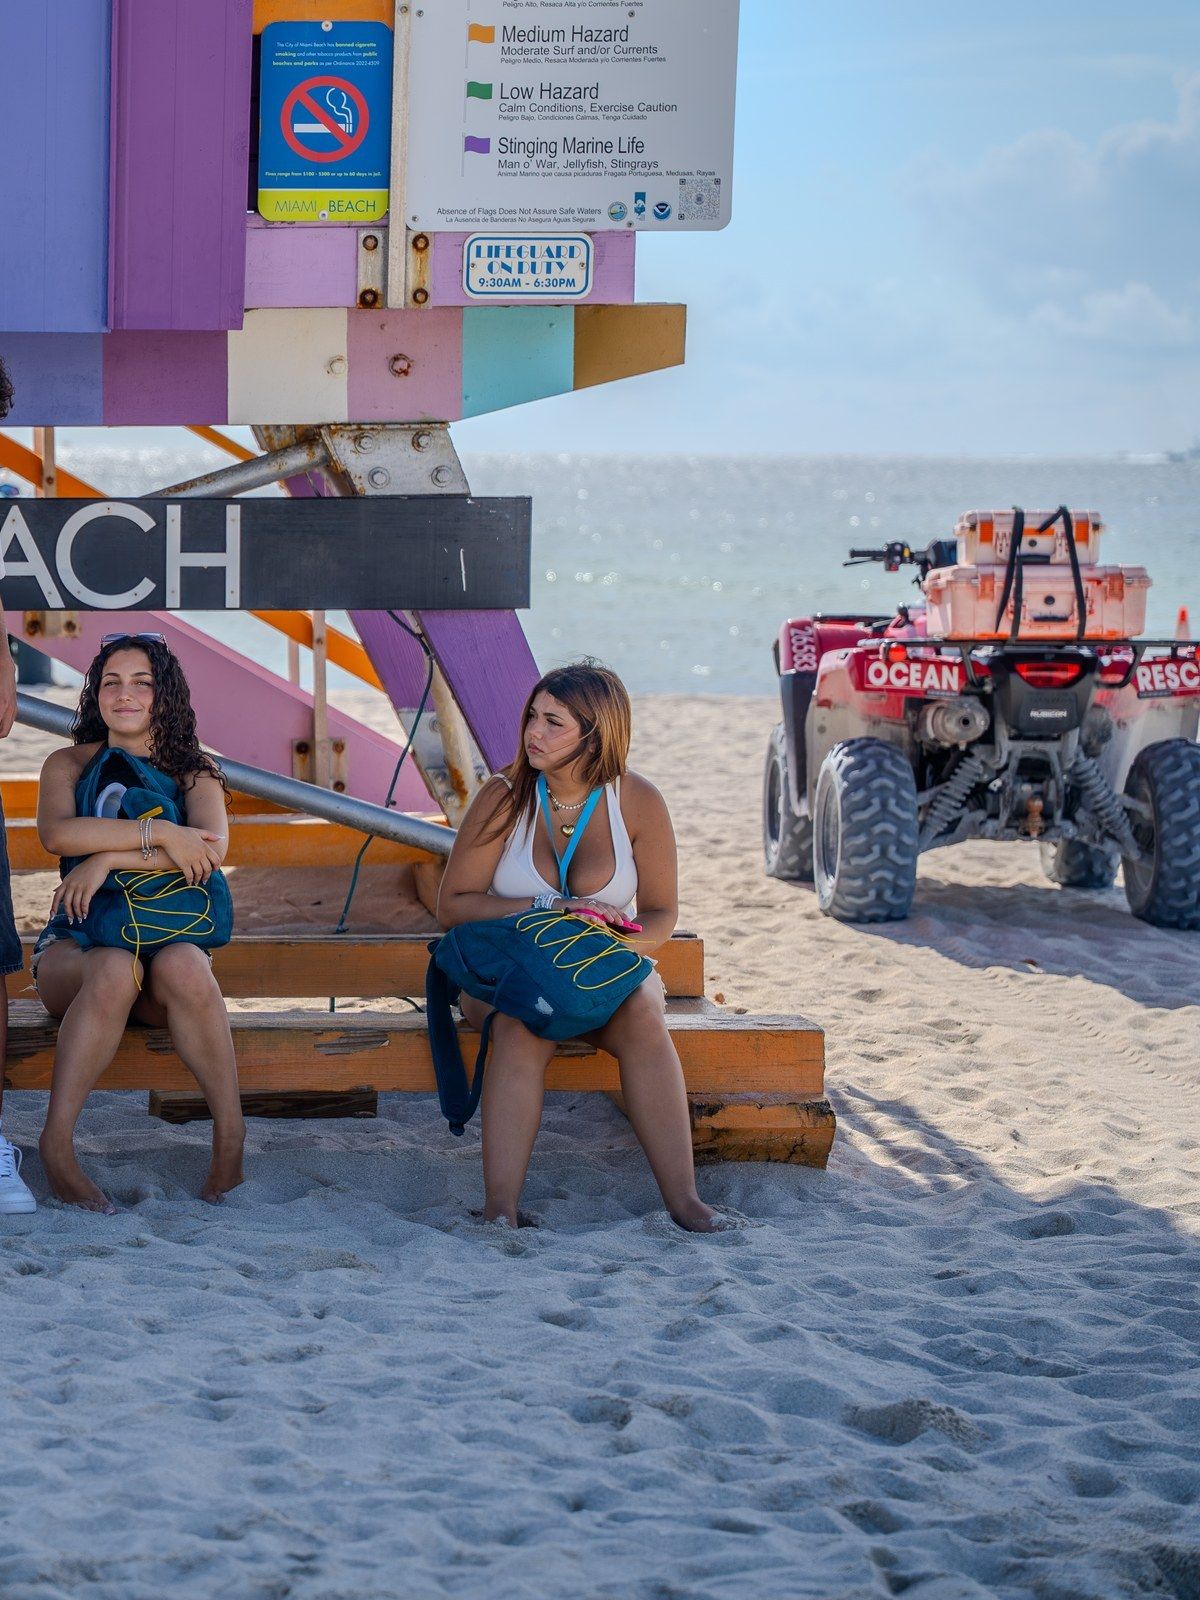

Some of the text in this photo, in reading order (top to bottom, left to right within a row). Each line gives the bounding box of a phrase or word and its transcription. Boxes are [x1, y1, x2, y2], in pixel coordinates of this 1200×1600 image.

[502, 25, 629, 43] Medium Hazard
[501, 44, 658, 56] Moderate Surf and/or Currents
[500, 82, 599, 99] Low Hazard
[499, 102, 677, 112] Calm Conditions, Exercise Caution
[498, 137, 644, 158] Stinging Marine Life
[497, 160, 520, 168] Man
[536, 160, 559, 168] War,
[563, 159, 607, 170] Jellyfish,
[611, 159, 659, 170] Stingrays
[275, 200, 376, 212] MIAMI BEACH
[478, 208, 497, 216] Flags
[476, 245, 581, 259] LIFEGUARD
[488, 262, 568, 274] ON DUTY
[479, 278, 521, 287] 9:30AM
[534, 278, 575, 287] 6:30PM
[790, 626, 817, 672] 26583
[868, 661, 959, 691] OCEAN
